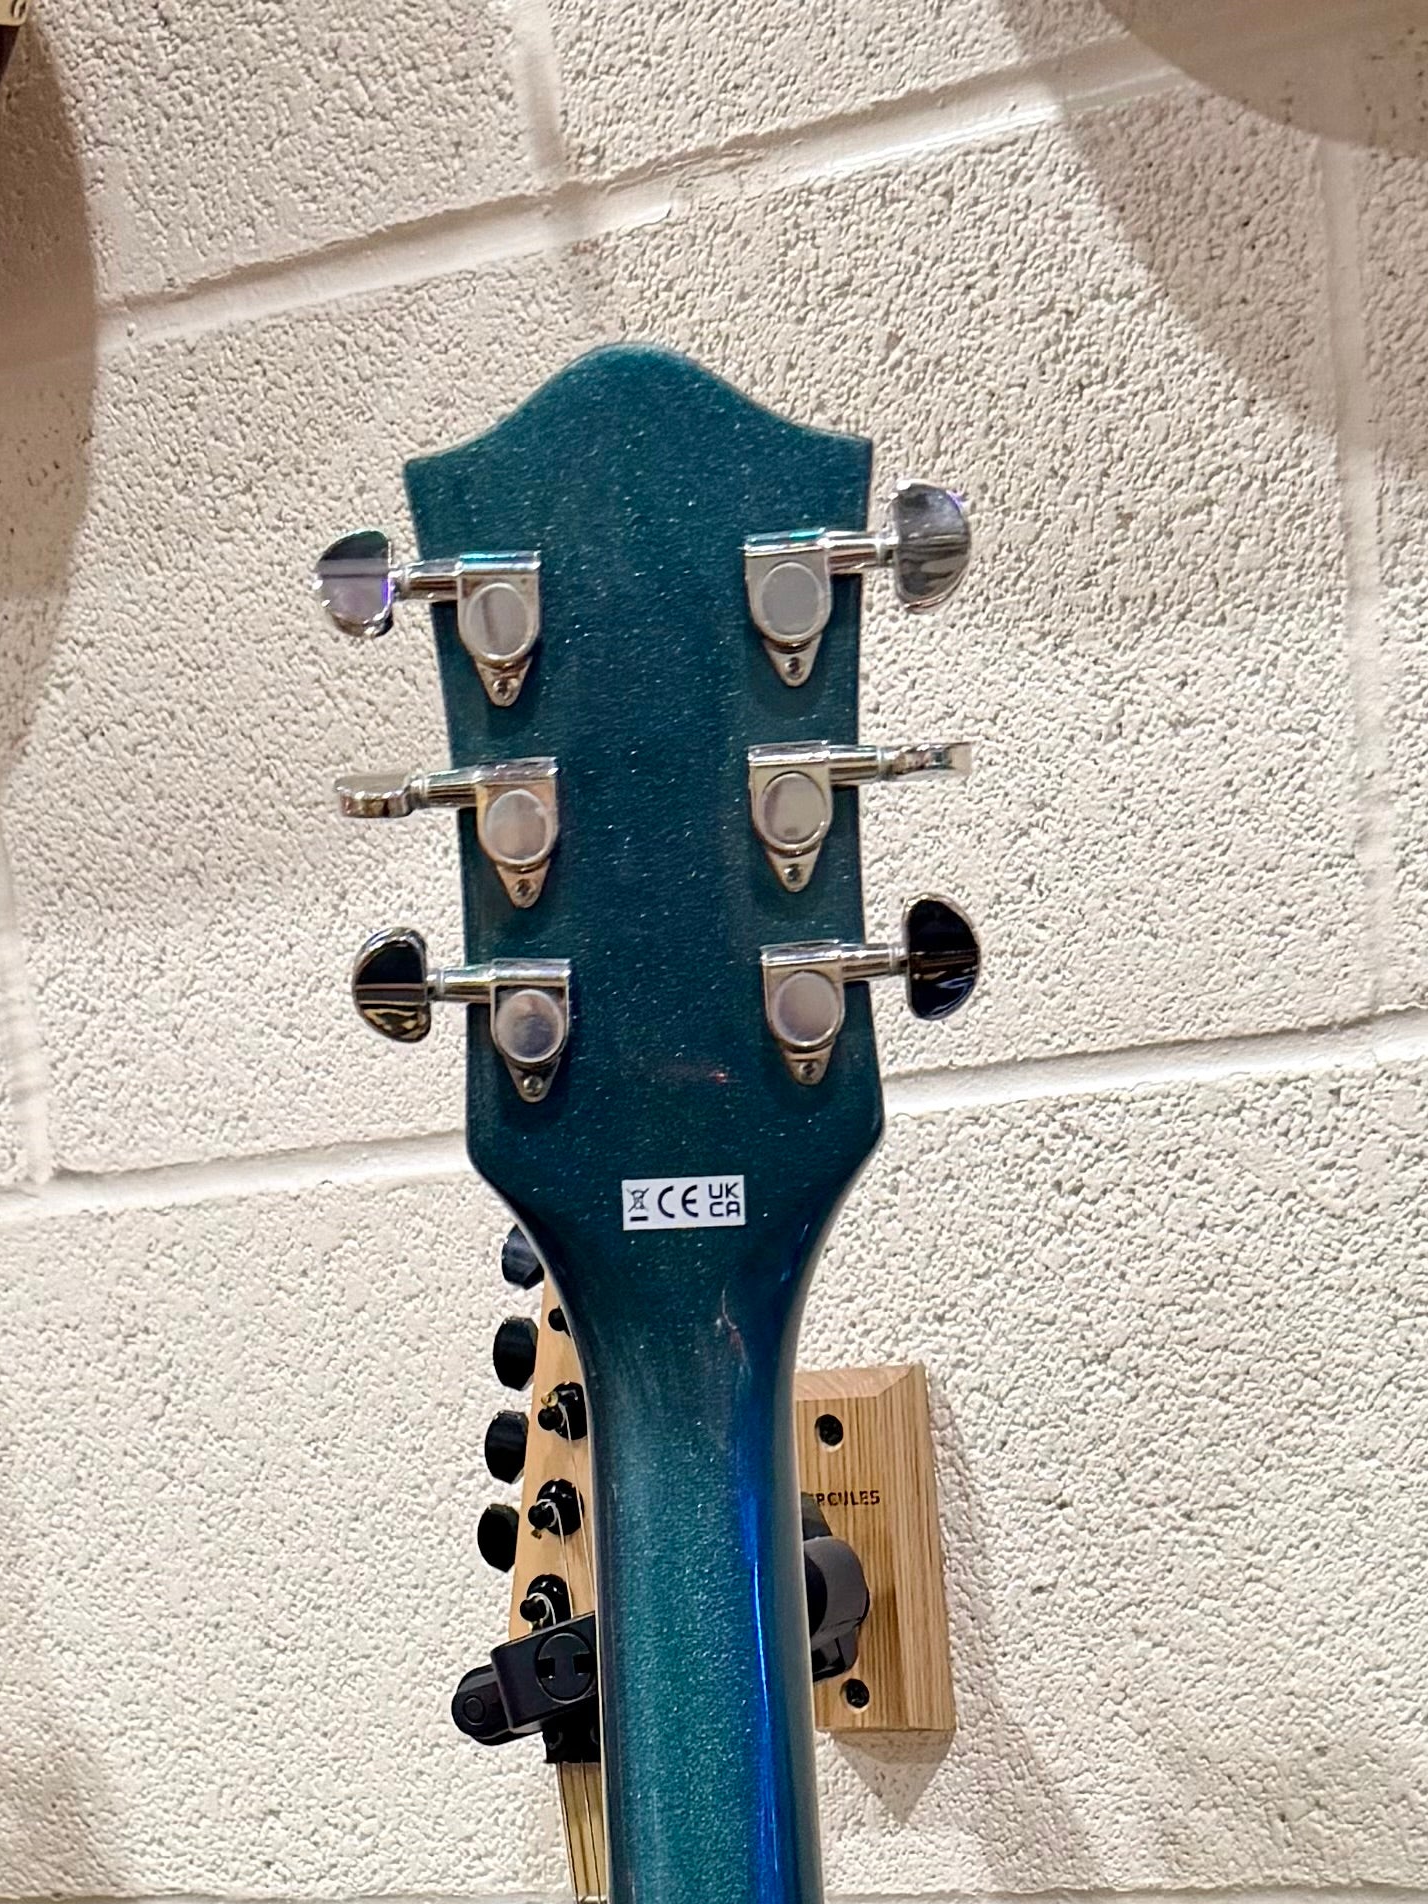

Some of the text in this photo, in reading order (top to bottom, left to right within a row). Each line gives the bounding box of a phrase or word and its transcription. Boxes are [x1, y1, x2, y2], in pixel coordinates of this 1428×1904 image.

[708, 1181, 740, 1200] UK
[657, 1184, 700, 1219] CE
[709, 1200, 741, 1218] CA
[815, 1489, 881, 1506] RCULES
